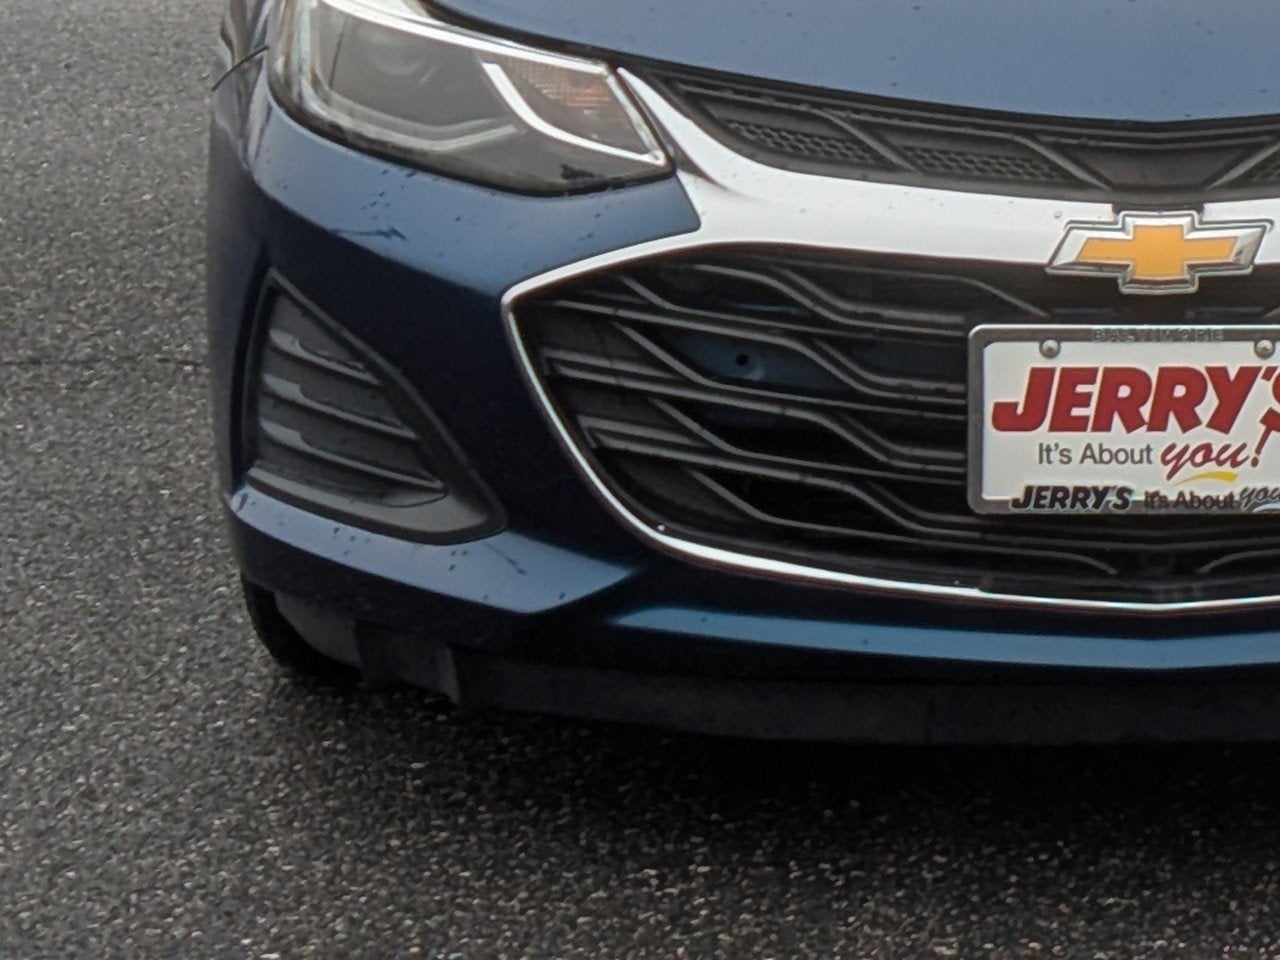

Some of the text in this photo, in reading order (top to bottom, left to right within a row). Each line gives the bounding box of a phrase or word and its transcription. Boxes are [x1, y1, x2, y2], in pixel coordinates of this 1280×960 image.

[1038, 428, 1272, 481] It's About you!
[1011, 485, 1135, 510] JERRY'S
[1144, 489, 1169, 510] It's
[1170, 489, 1238, 510] About
